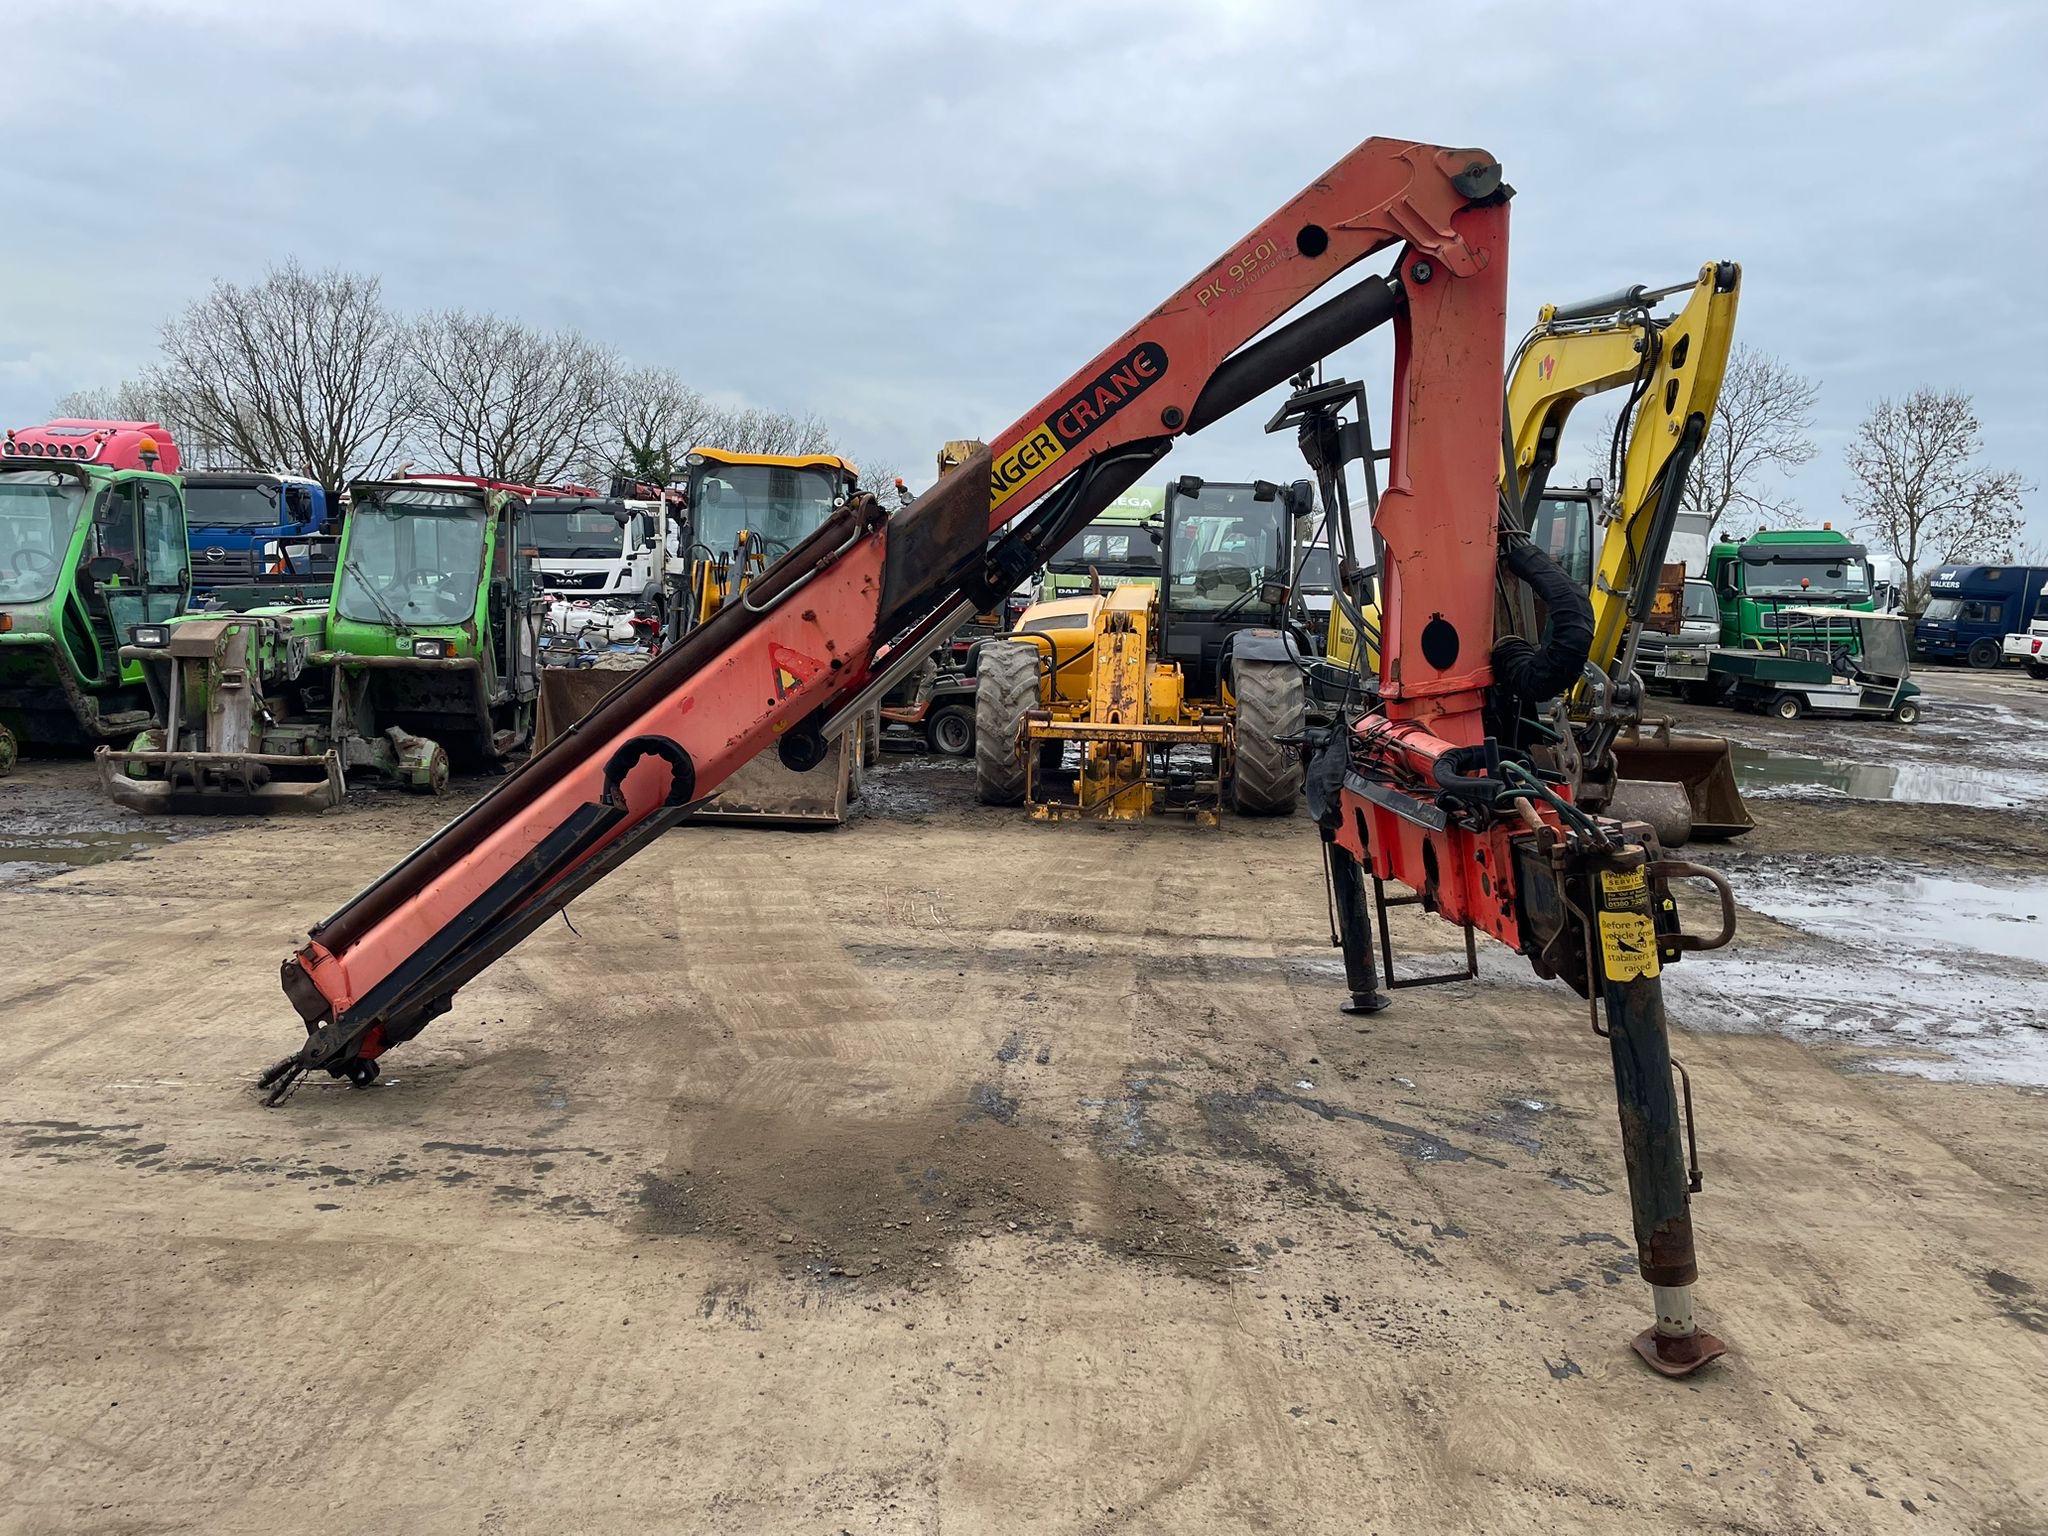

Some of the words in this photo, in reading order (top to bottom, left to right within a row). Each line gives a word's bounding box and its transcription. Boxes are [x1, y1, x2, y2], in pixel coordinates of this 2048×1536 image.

[1196, 278, 1226, 307] PK
[1056, 350, 1158, 439] CRANE
[1930, 580, 1961, 589] WALKERS
[1601, 920, 1631, 930] Before
[1607, 953, 1650, 962] stabilisers
